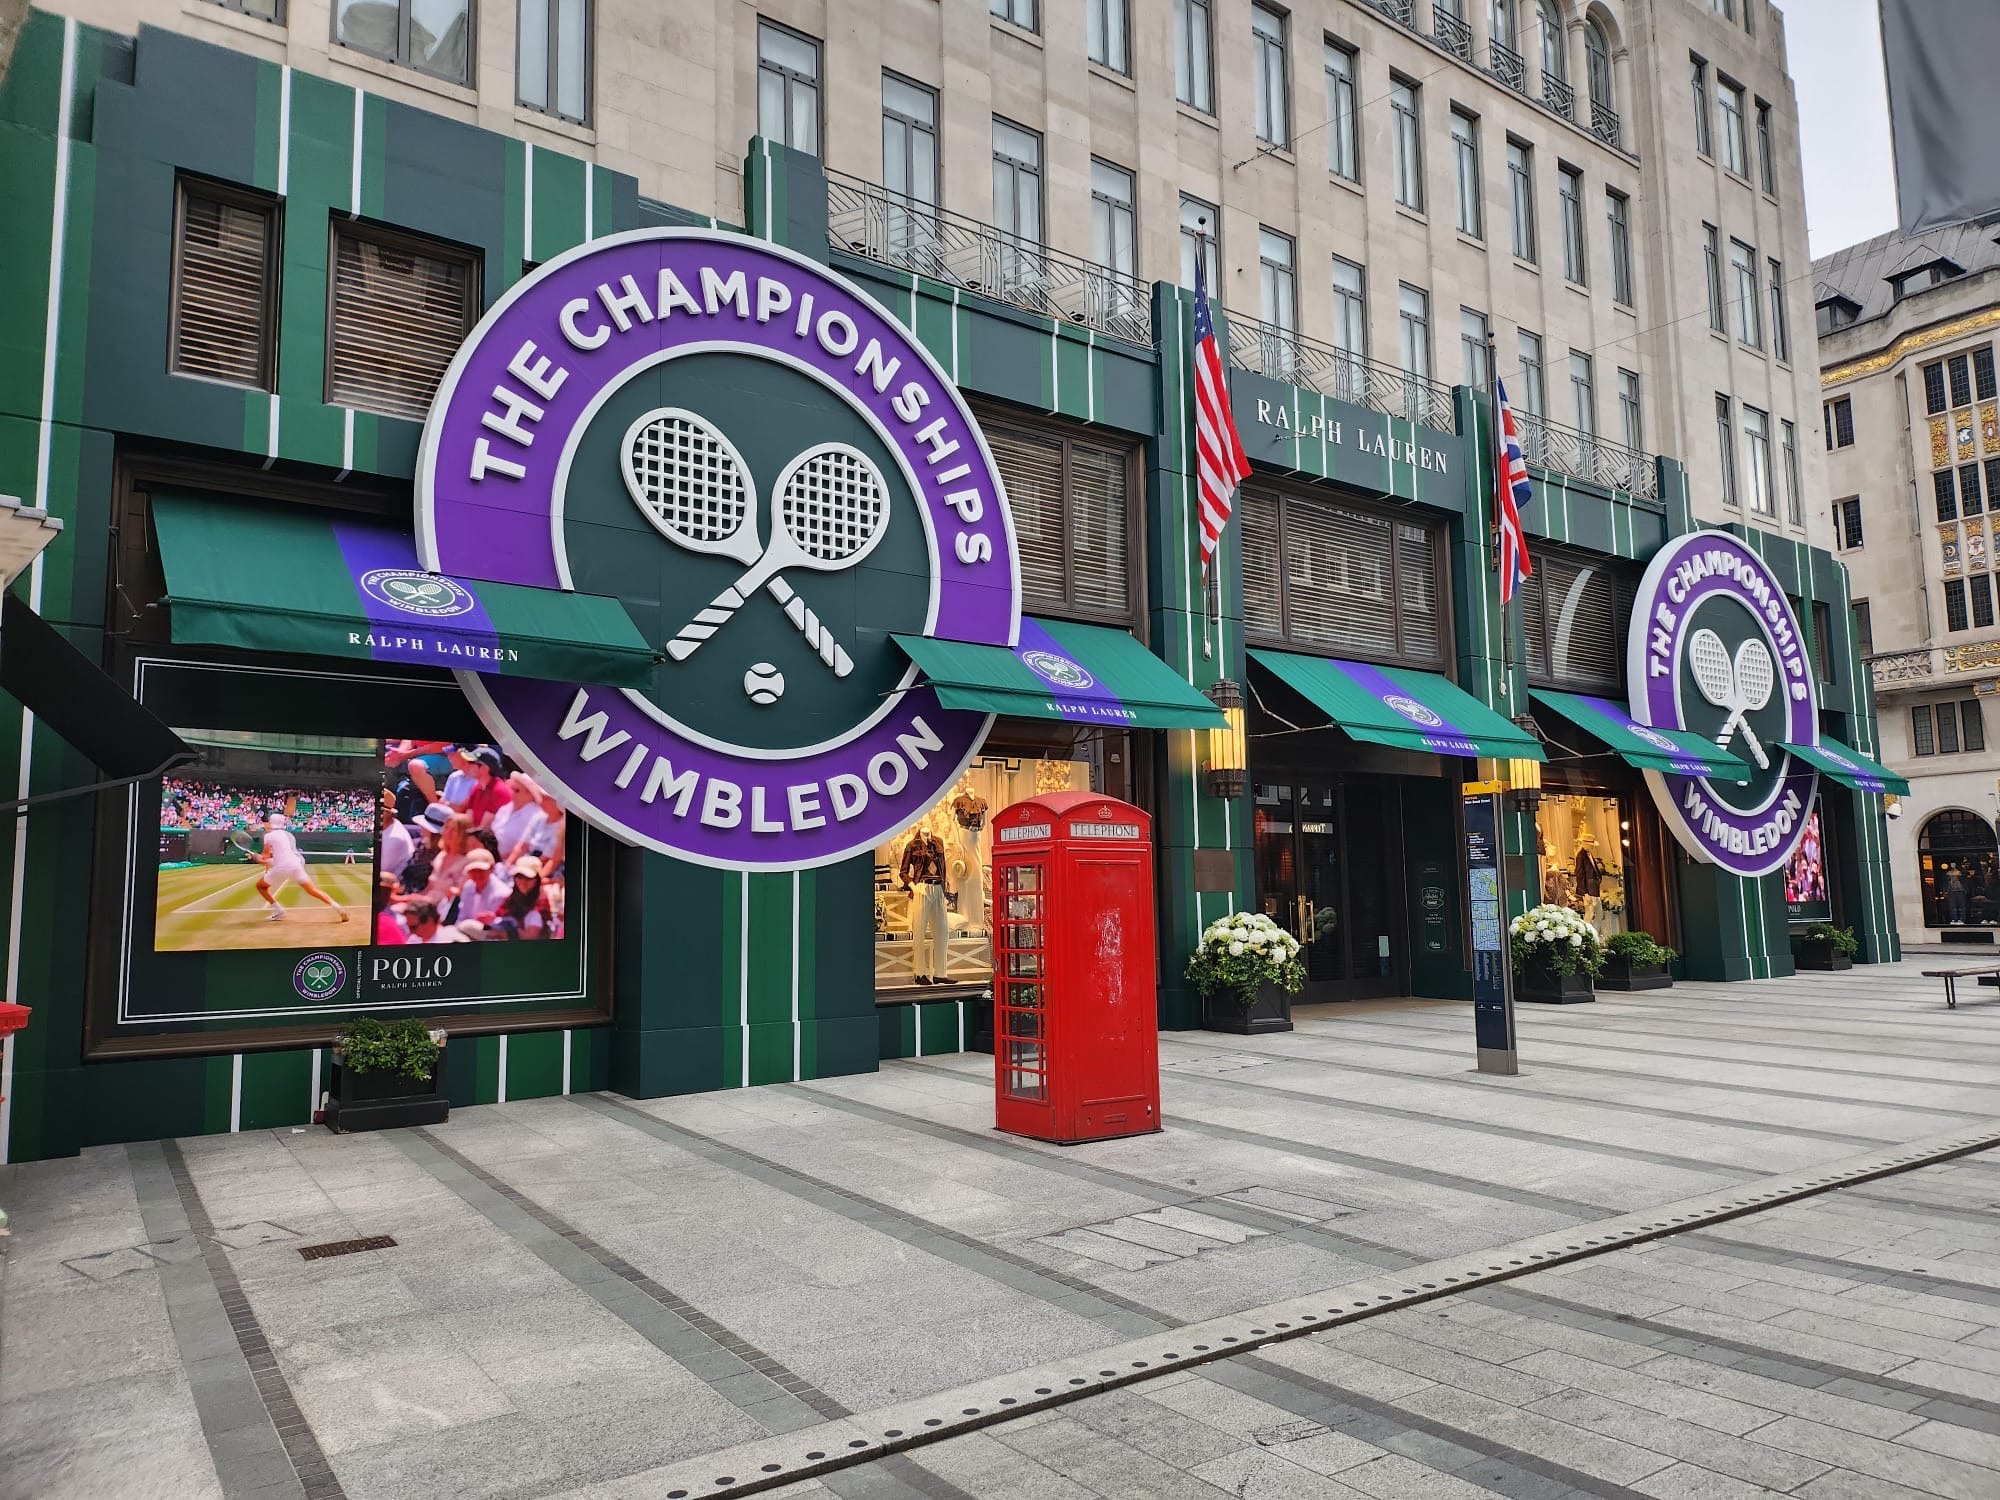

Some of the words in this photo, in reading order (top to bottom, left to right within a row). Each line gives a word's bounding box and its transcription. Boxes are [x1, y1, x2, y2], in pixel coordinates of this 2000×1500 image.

[470, 340, 569, 482] THE
[559, 267, 992, 566] CHAMPIONSHIPS
[1256, 398, 1342, 445] RALPH
[1358, 428, 1447, 474] LAUREN
[368, 573, 380, 586] THE
[376, 570, 465, 597] CHAMPIONSHIPS
[388, 598, 462, 615] WIMBLEDON
[1650, 602, 1676, 678] THE
[1667, 550, 1808, 702] CHAMPIONSHIPS
[348, 632, 424, 651] RALPH
[437, 641, 519, 662] LAUREN
[1046, 703, 1087, 714] RALPH
[1091, 707, 1137, 719] LAUREN
[557, 687, 944, 833] WIMBLEDON
[1073, 823, 1136, 838] TELEPHONE
[1684, 780, 1803, 856] WIMBLEDON
[1003, 825, 1049, 841] TELEPHONE
[303, 953, 344, 975] CHAMPIONSHIPS
[371, 955, 453, 981] POLO
[302, 986, 338, 999] WIMBLEDON
[381, 982, 408, 990] RALPH
[412, 980, 443, 988] LAUREN
